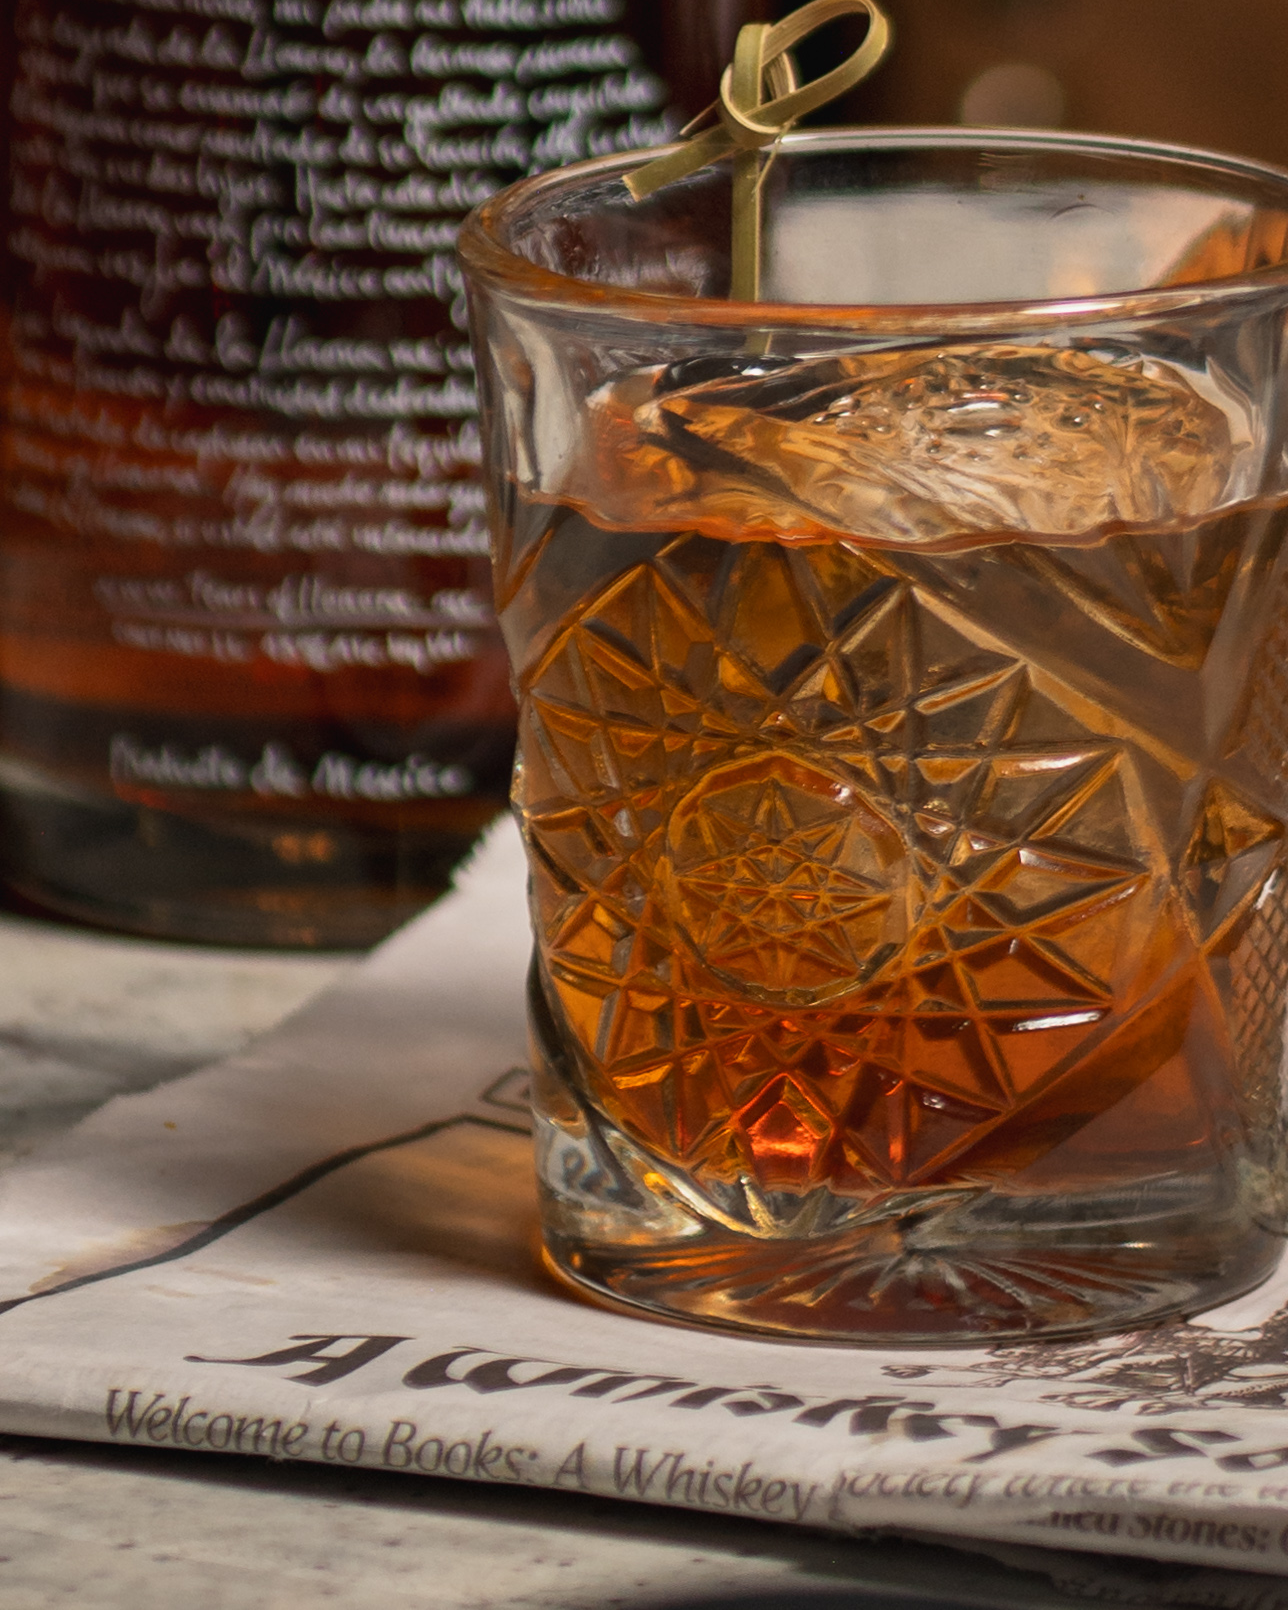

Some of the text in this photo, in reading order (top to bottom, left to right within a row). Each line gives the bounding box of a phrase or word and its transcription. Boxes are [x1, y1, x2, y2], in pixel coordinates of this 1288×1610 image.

[182, 1334, 415, 1388] A
[106, 1388, 310, 1458] Welcome
[322, 1420, 366, 1463] to
[381, 1420, 539, 1485] Books:
[553, 1441, 589, 1490] A
[612, 1446, 819, 1522] Whiskey
